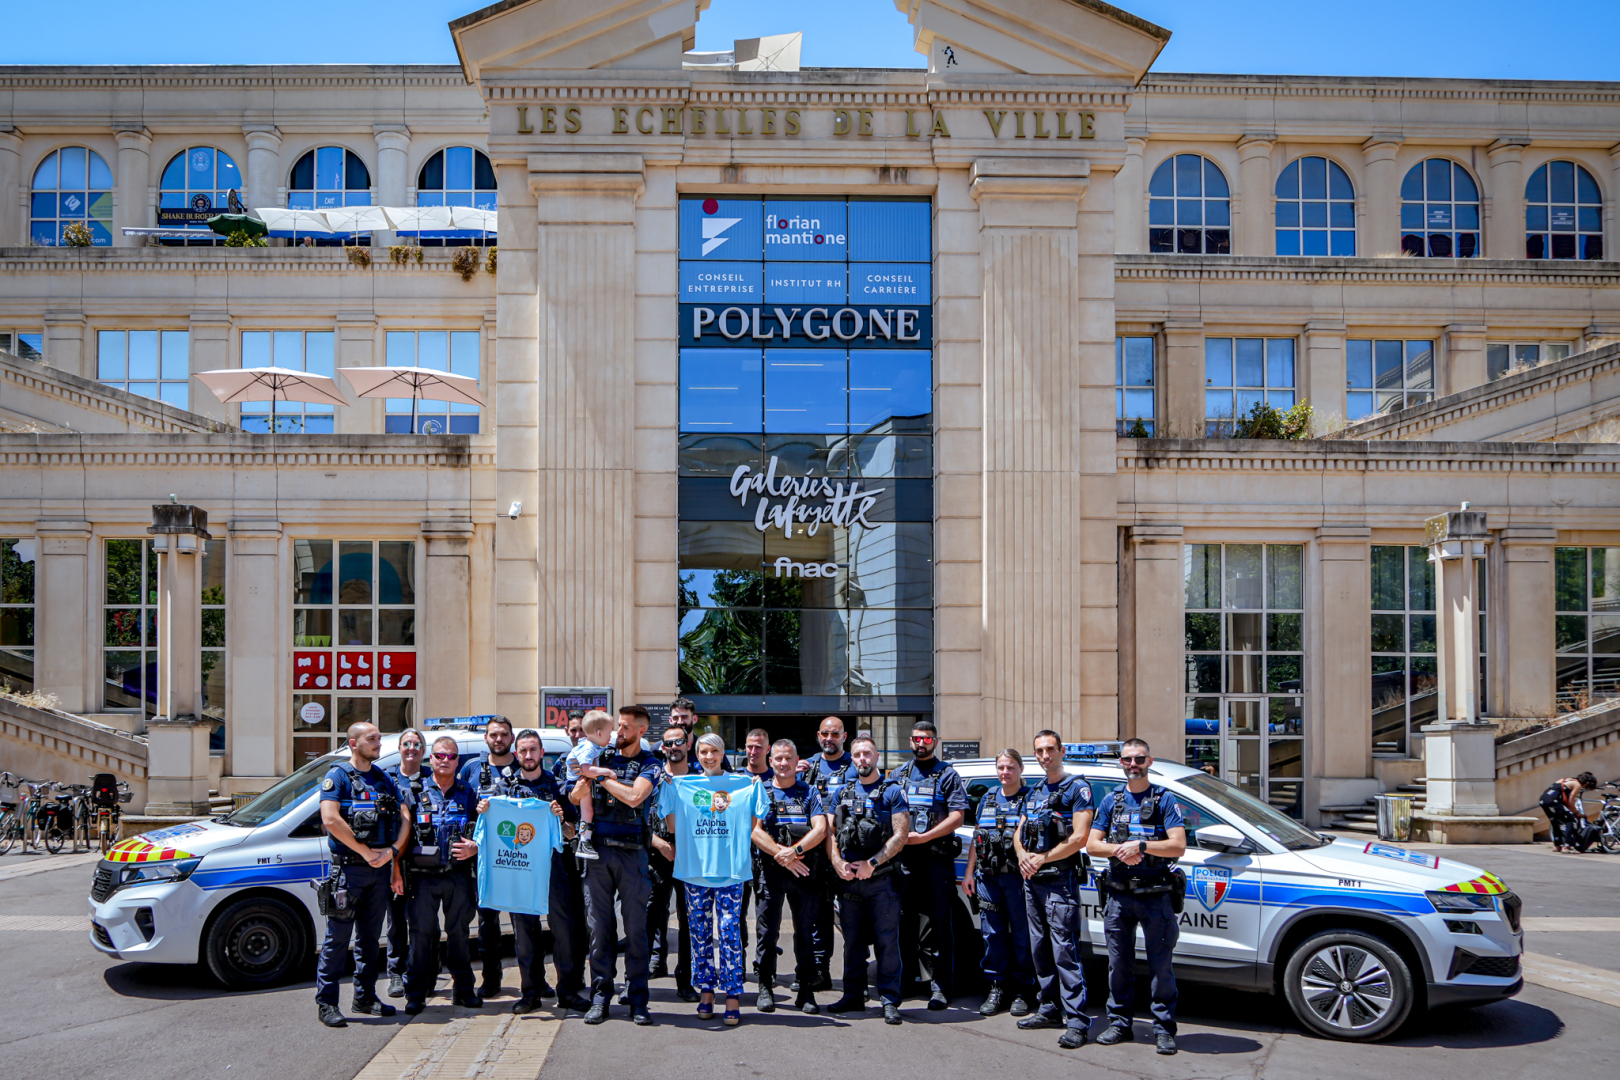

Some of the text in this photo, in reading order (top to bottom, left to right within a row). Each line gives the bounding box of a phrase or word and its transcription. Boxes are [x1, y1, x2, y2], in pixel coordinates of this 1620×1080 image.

[517, 106, 1097, 139] LES ECHELLES DE LA VILLE
[161, 212, 185, 220] SHAKE
[186, 212, 214, 220] BURGER
[765, 214, 821, 230] florian
[765, 230, 846, 246] mantione
[697, 273, 745, 282] CONSEIL
[866, 274, 914, 283] CONSEIL
[688, 285, 754, 293] ENTREPRISE
[770, 279, 842, 288] INSTITUT RH
[863, 284, 917, 294] CARRIÈRE
[693, 307, 921, 341] POLYGONE
[730, 455, 835, 507] Galeries
[754, 482, 886, 539] Lafayette
[773, 556, 839, 578] fnac
[298, 654, 392, 670] MILLE
[299, 673, 412, 688] FORMES
[546, 697, 607, 707] MONTPELLIER
[696, 818, 727, 828] L'Alpha
[695, 826, 730, 836] deVictor
[497, 848, 528, 859] L'Alpha
[257, 854, 283, 865] PMT 5
[495, 857, 530, 868] deVictor
[1196, 868, 1229, 878] POLICE
